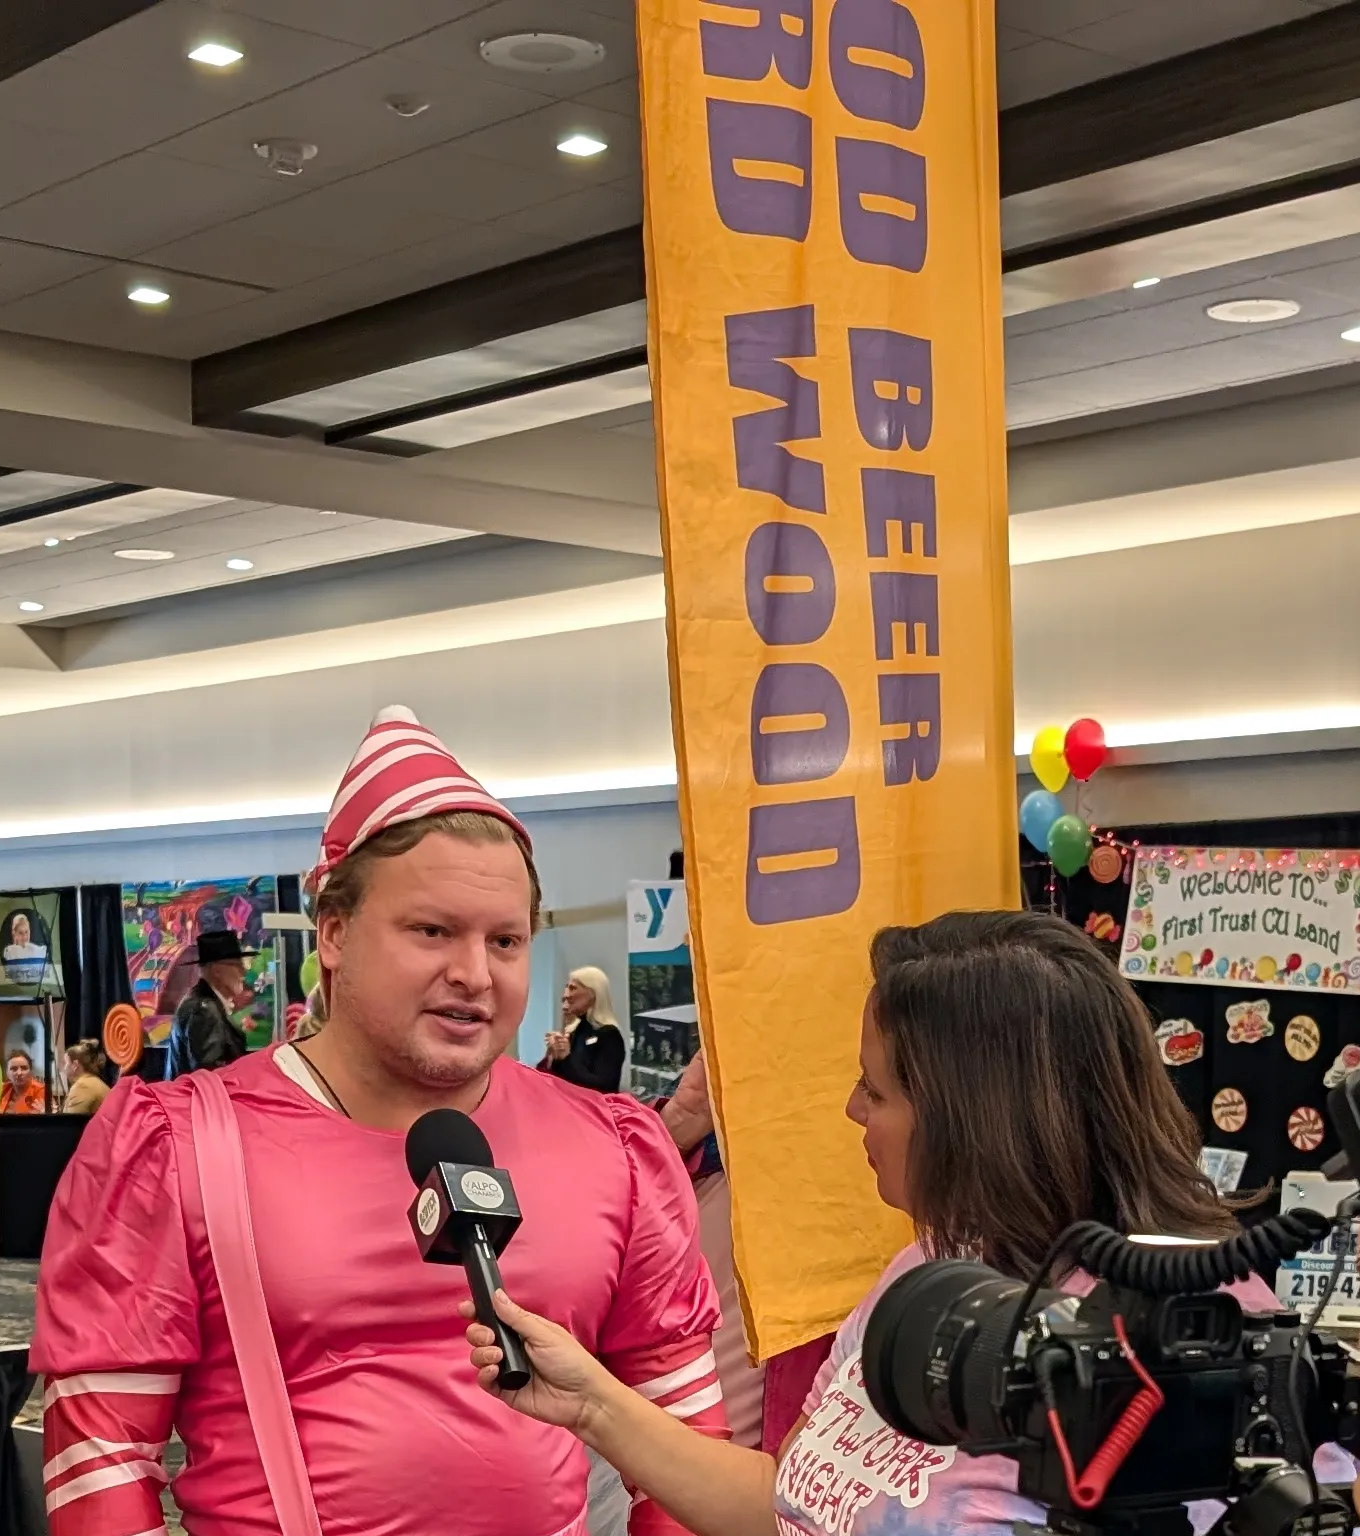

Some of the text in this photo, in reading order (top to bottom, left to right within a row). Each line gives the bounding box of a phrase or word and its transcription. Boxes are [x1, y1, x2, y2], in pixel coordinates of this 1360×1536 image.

[847, 327, 942, 788] BEER
[723, 304, 861, 927] WOOD
[1288, 871, 1328, 907] TO...
[1162, 905, 1340, 956] First Trust CU Land
[463, 1180, 499, 1192] VALPO
[466, 1190, 502, 1199] CHAMBER
[778, 1441, 873, 1534] NIGHT
